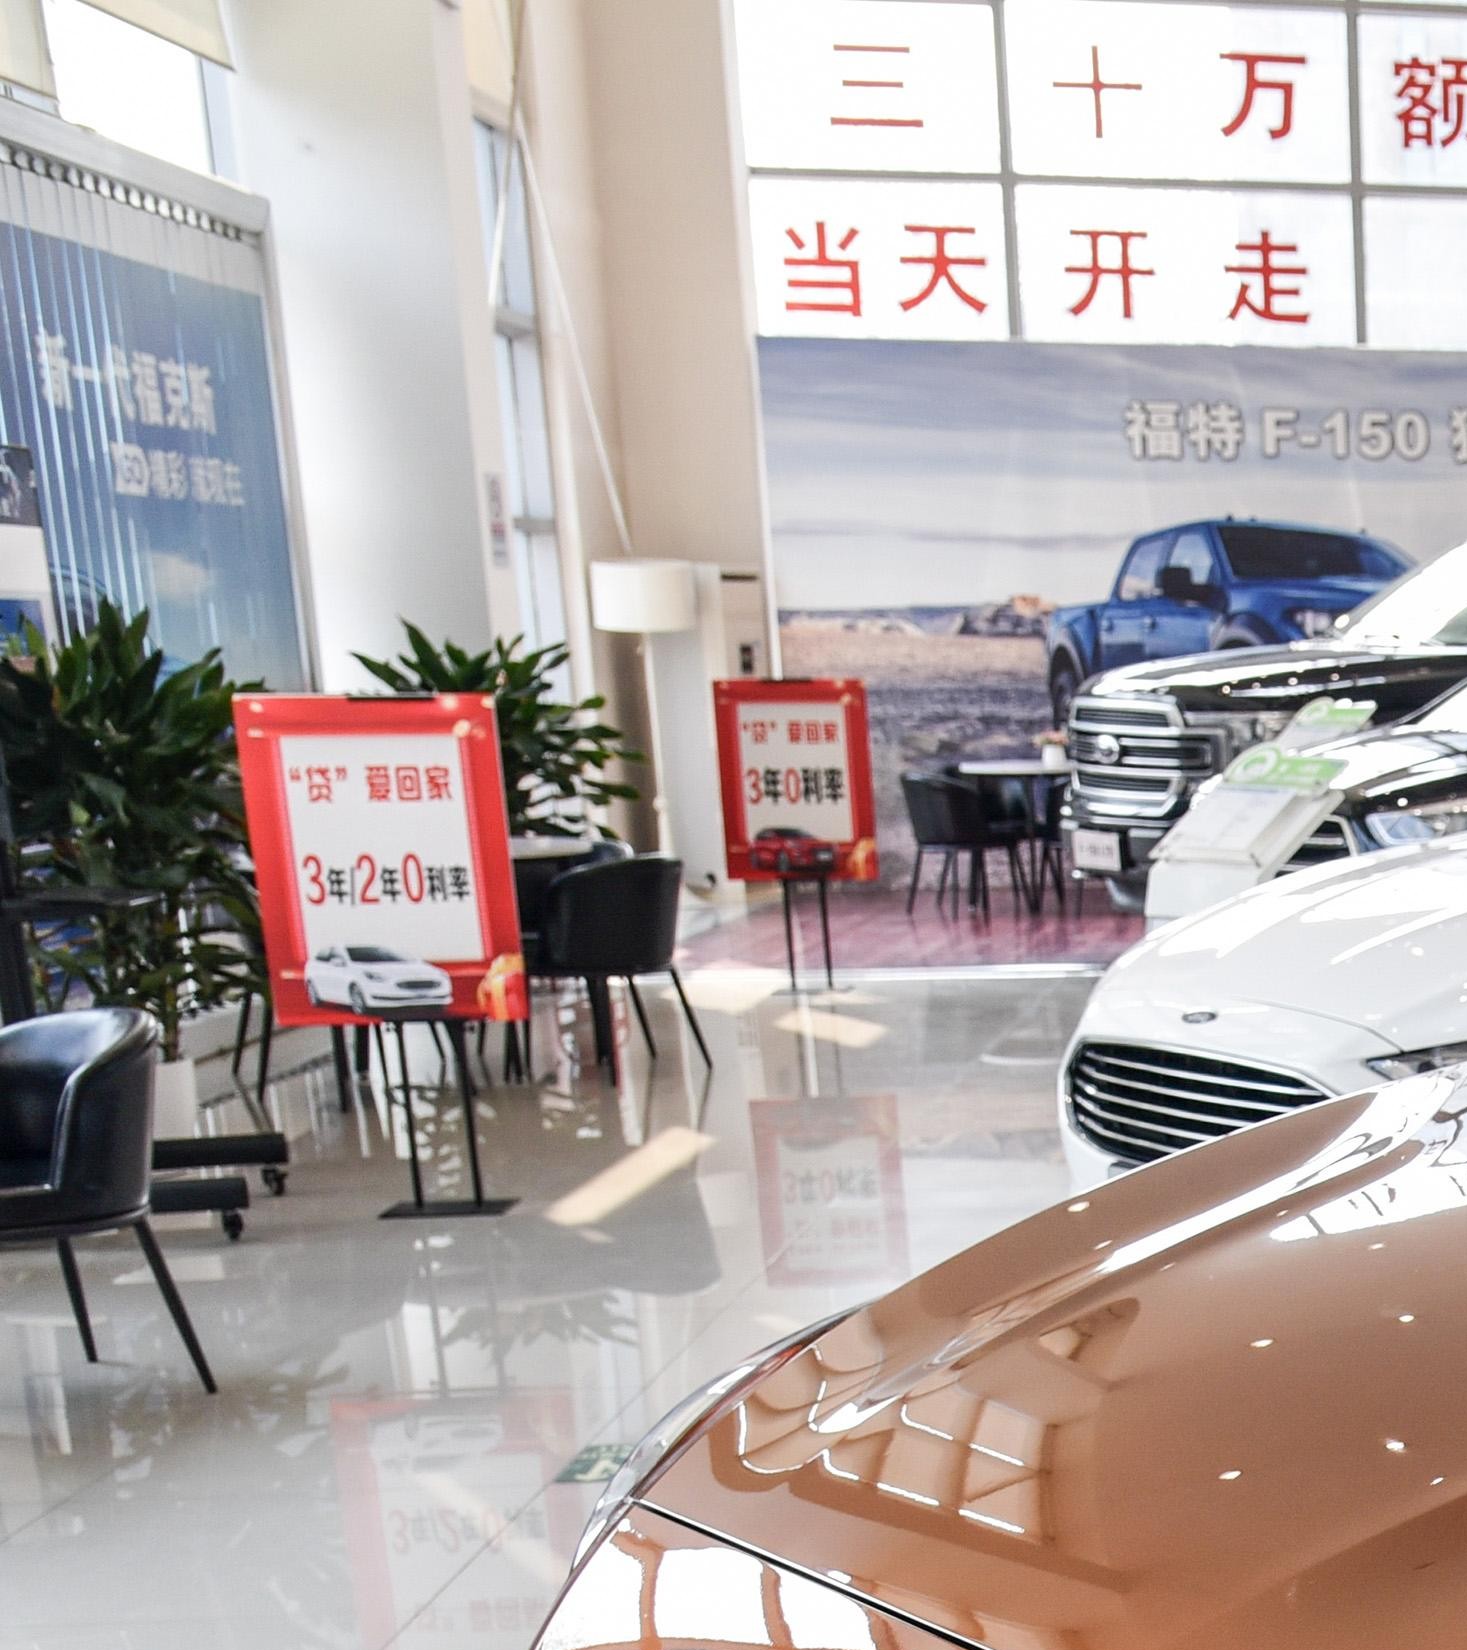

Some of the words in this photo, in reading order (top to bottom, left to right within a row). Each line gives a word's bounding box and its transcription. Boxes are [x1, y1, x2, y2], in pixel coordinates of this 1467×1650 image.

[1124, 400, 1245, 461] 福特
[1262, 408, 1431, 462] F-150
[366, 764, 452, 801] 爱回家
[747, 767, 844, 805] 3年0利率
